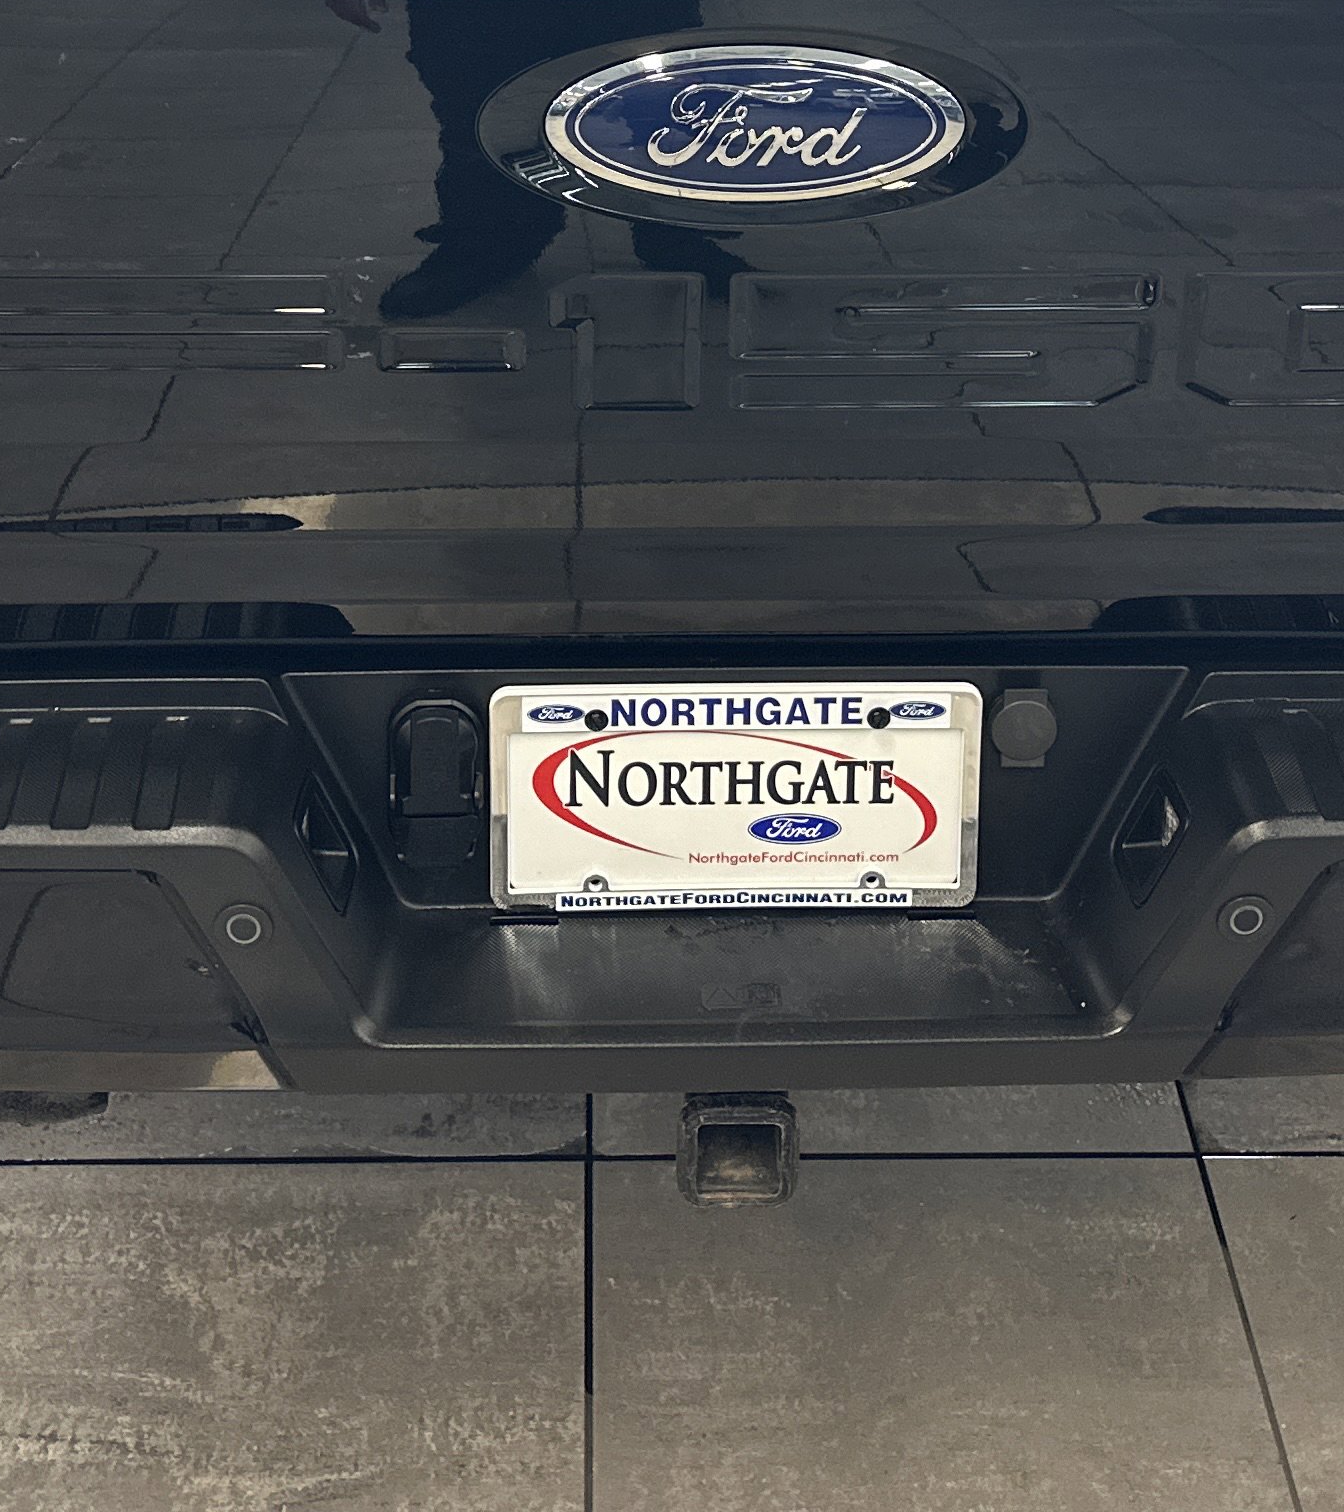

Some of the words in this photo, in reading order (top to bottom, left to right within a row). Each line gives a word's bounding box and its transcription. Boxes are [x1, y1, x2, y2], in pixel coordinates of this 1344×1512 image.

[648, 83, 868, 167] Ford
[537, 707, 573, 720] Ford
[611, 696, 863, 727] NORTHGATE
[899, 703, 935, 716] Ford
[564, 750, 895, 807] NORTHGATE
[765, 817, 823, 838] Ford
[688, 850, 899, 865] NorthgateFordCincinnati.com
[561, 892, 908, 907] NORTHGATEFORDCINCINNATI.COM
